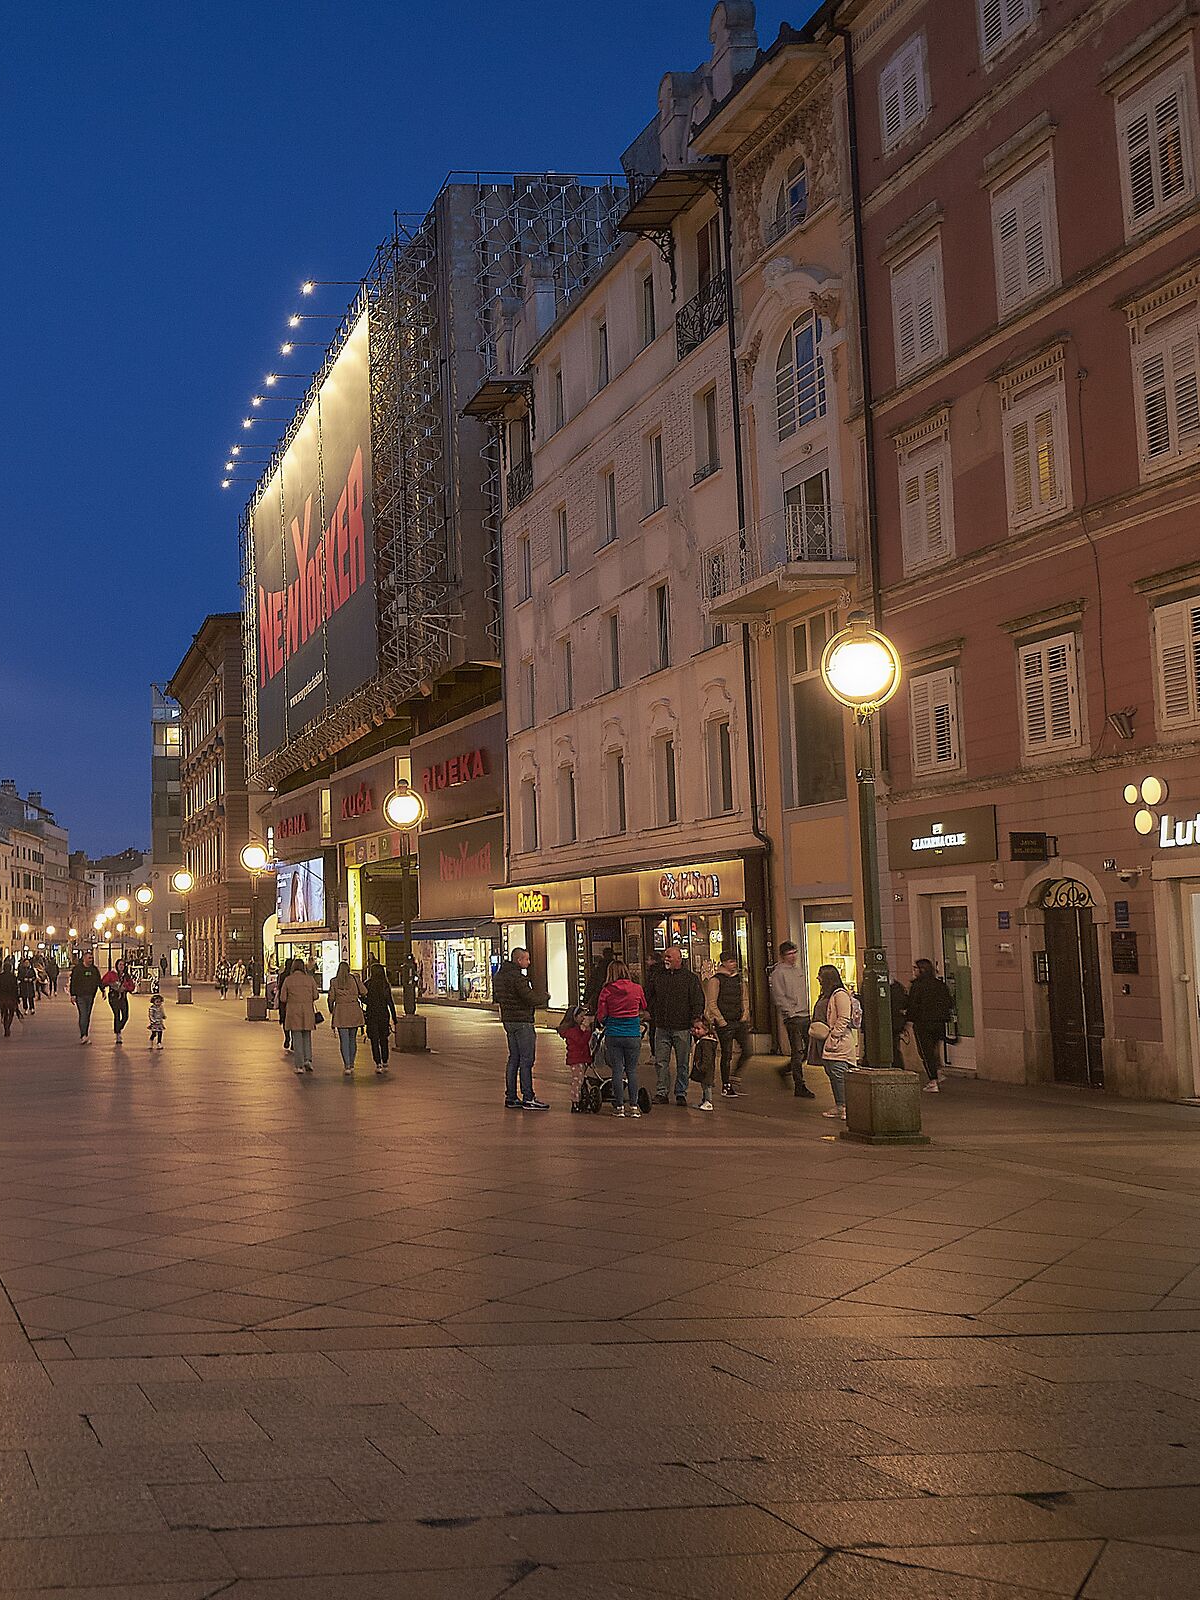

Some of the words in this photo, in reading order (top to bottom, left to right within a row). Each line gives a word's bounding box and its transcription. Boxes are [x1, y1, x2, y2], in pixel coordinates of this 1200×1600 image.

[422, 749, 485, 793] RIJEKA
[341, 781, 374, 819] KUĆA
[277, 812, 308, 839] ROBNA
[945, 832, 967, 847] CELJE
[518, 890, 543, 913] Rodea
